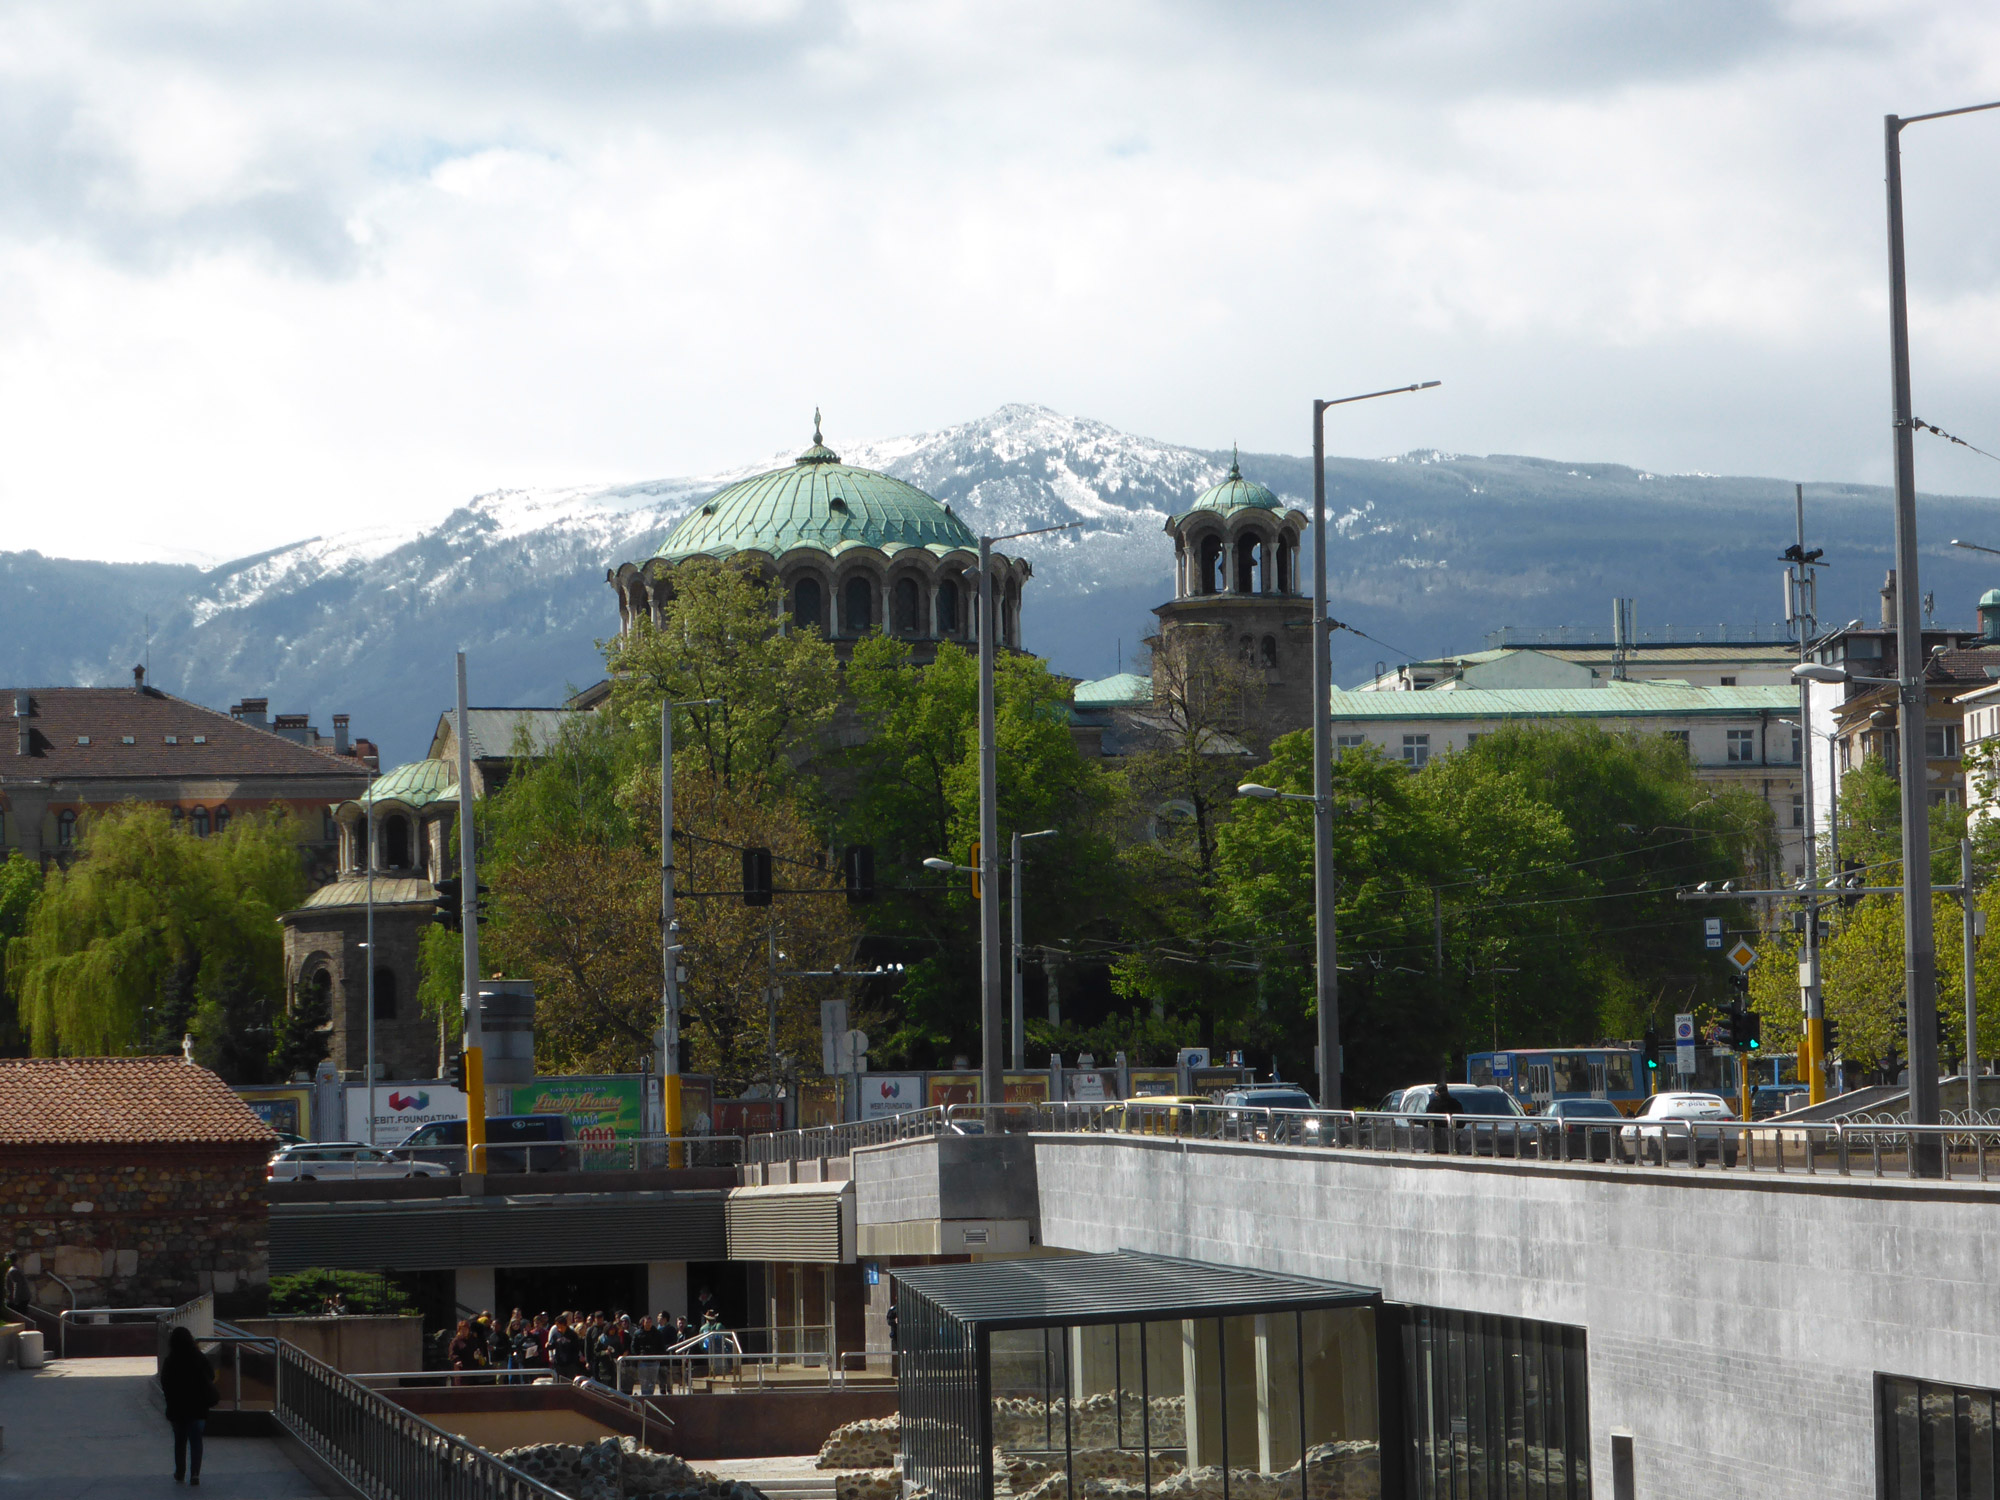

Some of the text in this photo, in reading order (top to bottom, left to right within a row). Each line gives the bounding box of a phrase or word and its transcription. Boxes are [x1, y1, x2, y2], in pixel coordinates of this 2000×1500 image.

[1015, 1085, 1032, 1096] SLOT
[532, 1092, 622, 1113] Lucky Boxes
[572, 1113, 599, 1125] МАЙ
